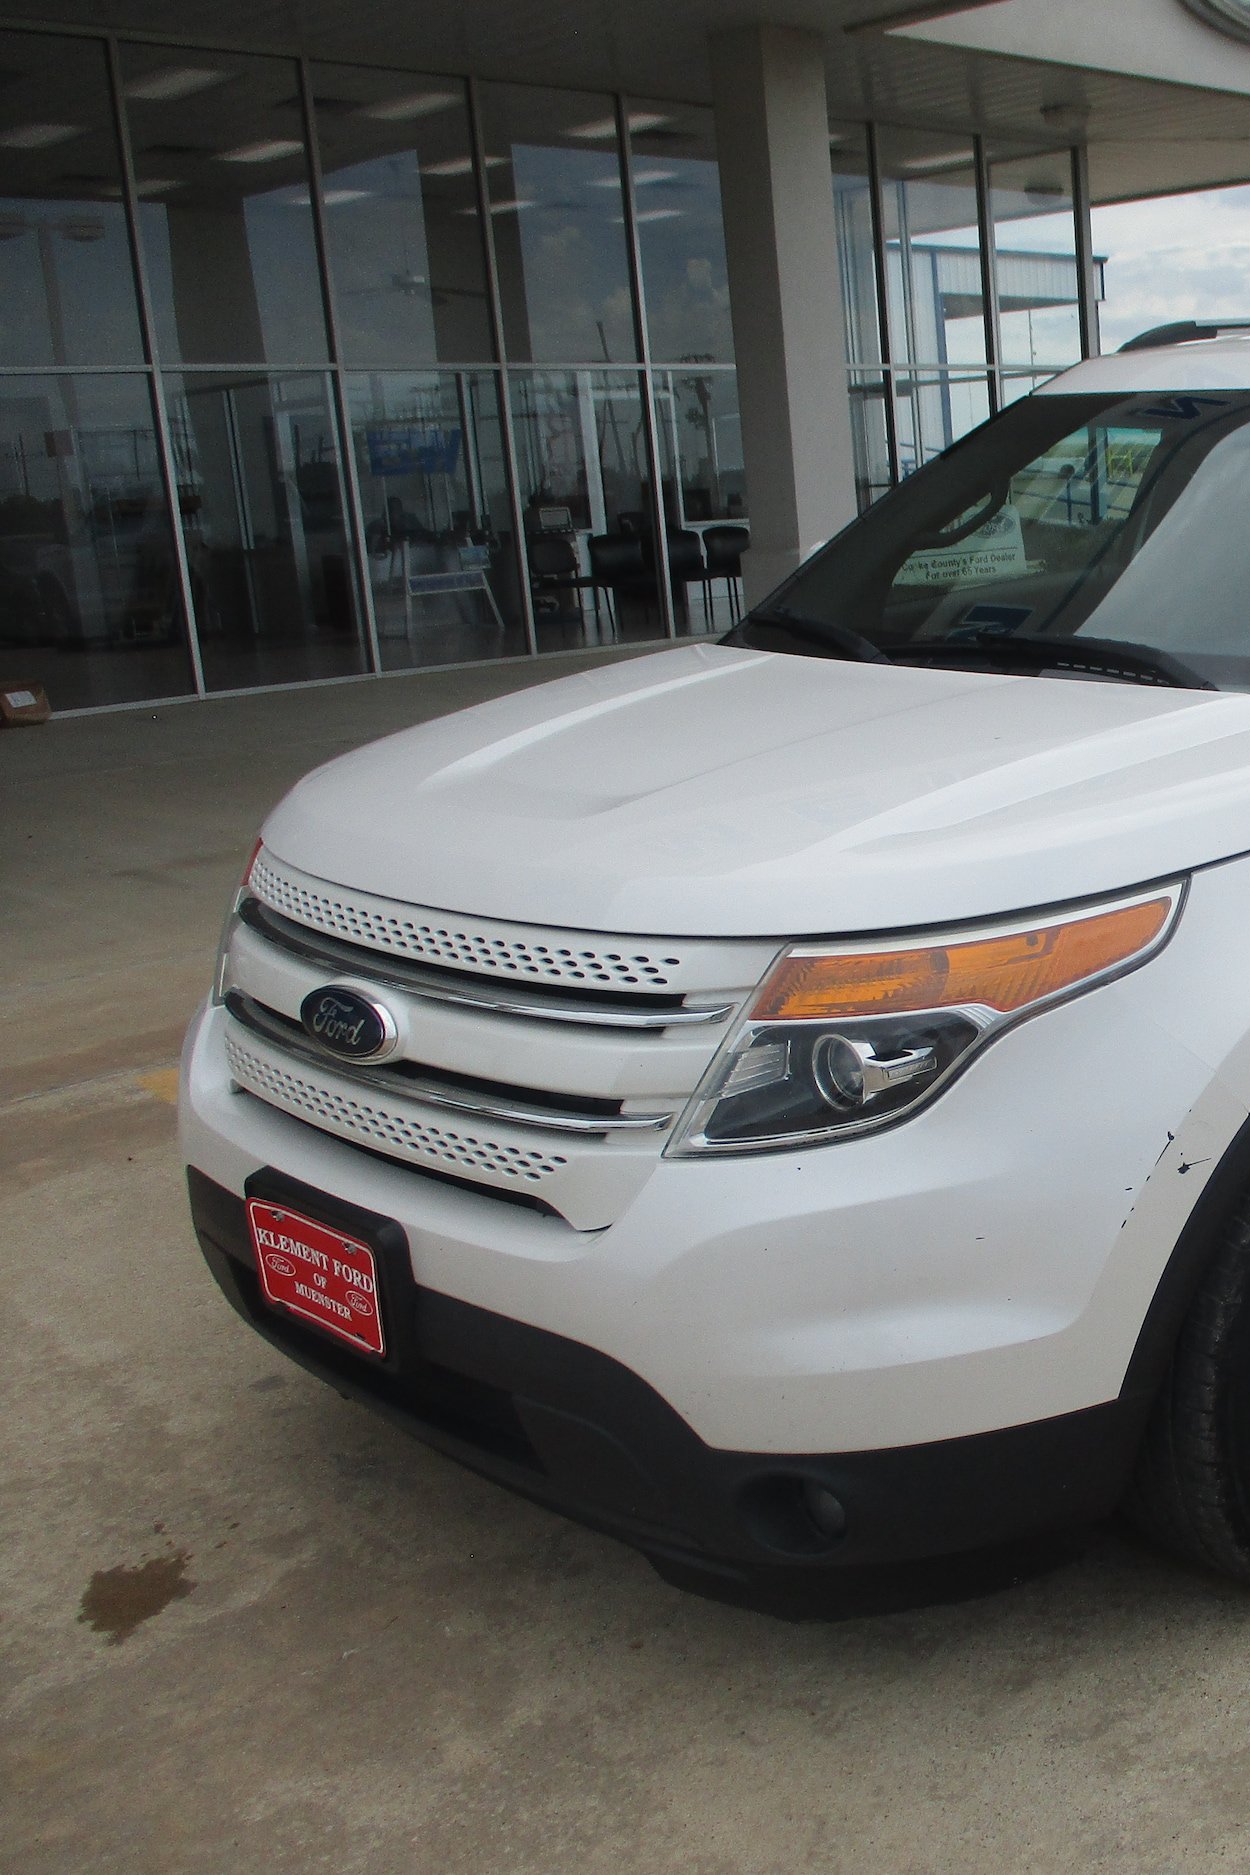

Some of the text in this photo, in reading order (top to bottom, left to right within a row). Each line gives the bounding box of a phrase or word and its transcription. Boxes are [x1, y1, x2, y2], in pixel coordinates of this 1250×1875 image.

[931, 555, 967, 569] County's
[969, 554, 988, 564] Ford
[990, 553, 1015, 562] Dealer
[975, 564, 997, 574] Years
[313, 997, 364, 1045] Ford
[257, 1227, 373, 1293] KLEMENT FORD
[269, 1258, 290, 1274] Ford
[313, 1273, 327, 1289] OF
[295, 1281, 352, 1321] MUENSTER
[350, 1293, 369, 1312] Ford
